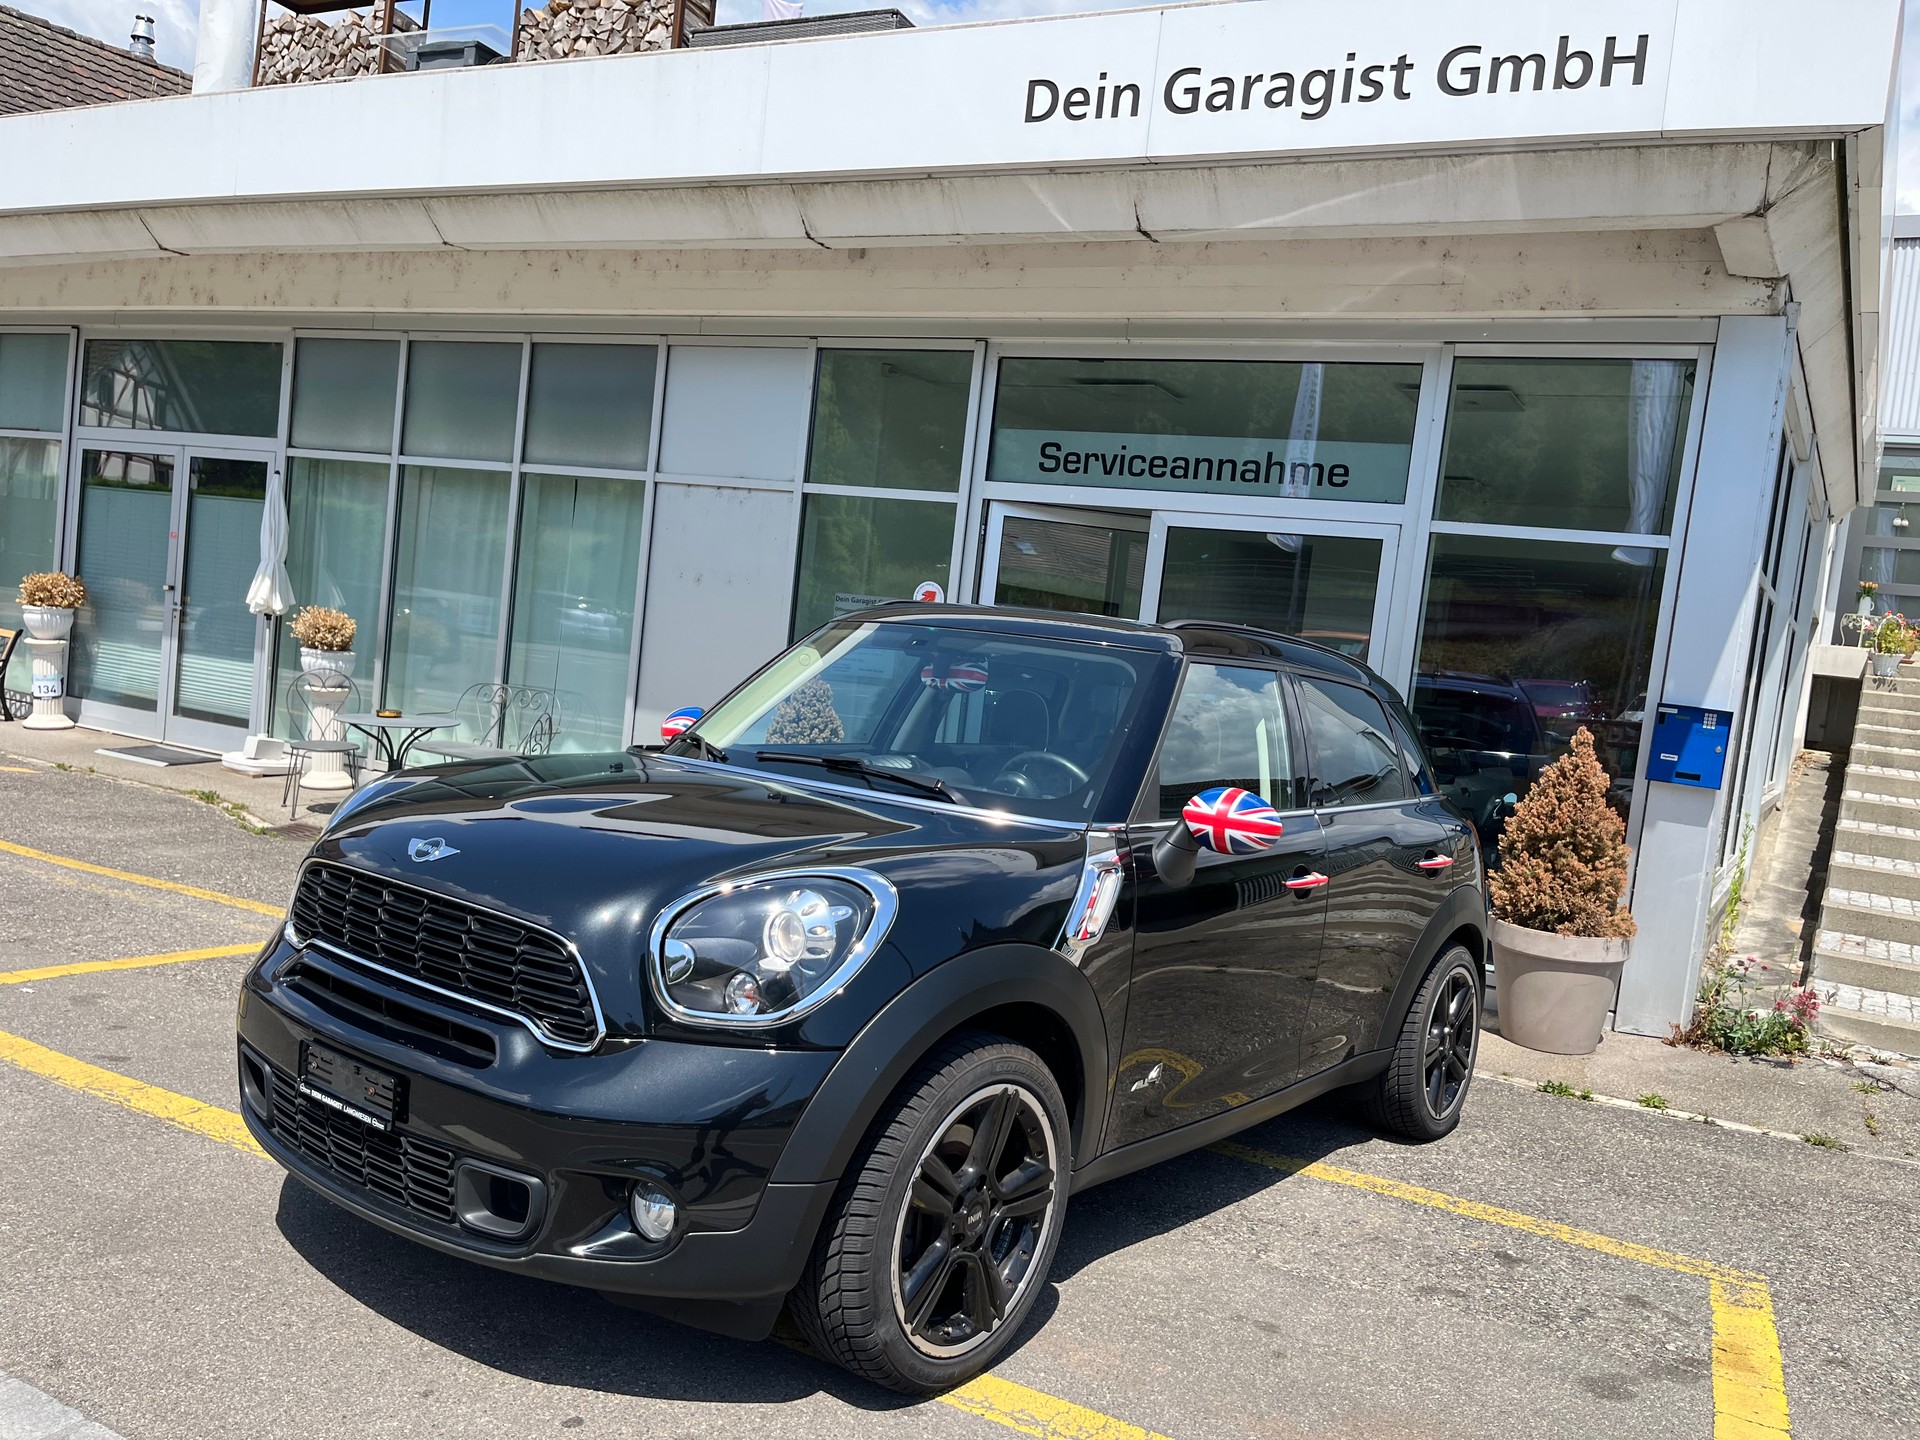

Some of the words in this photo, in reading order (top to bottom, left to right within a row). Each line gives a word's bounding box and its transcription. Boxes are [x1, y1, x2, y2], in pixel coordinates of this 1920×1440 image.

[1024, 72, 1141, 123] Dein
[1162, 52, 1414, 120] Garagist
[1436, 34, 1650, 97] GmbH
[1038, 441, 1350, 488] Serviceannahme
[835, 595, 849, 603] Dein
[850, 596, 877, 606] Garagist
[37, 684, 57, 694] 134
